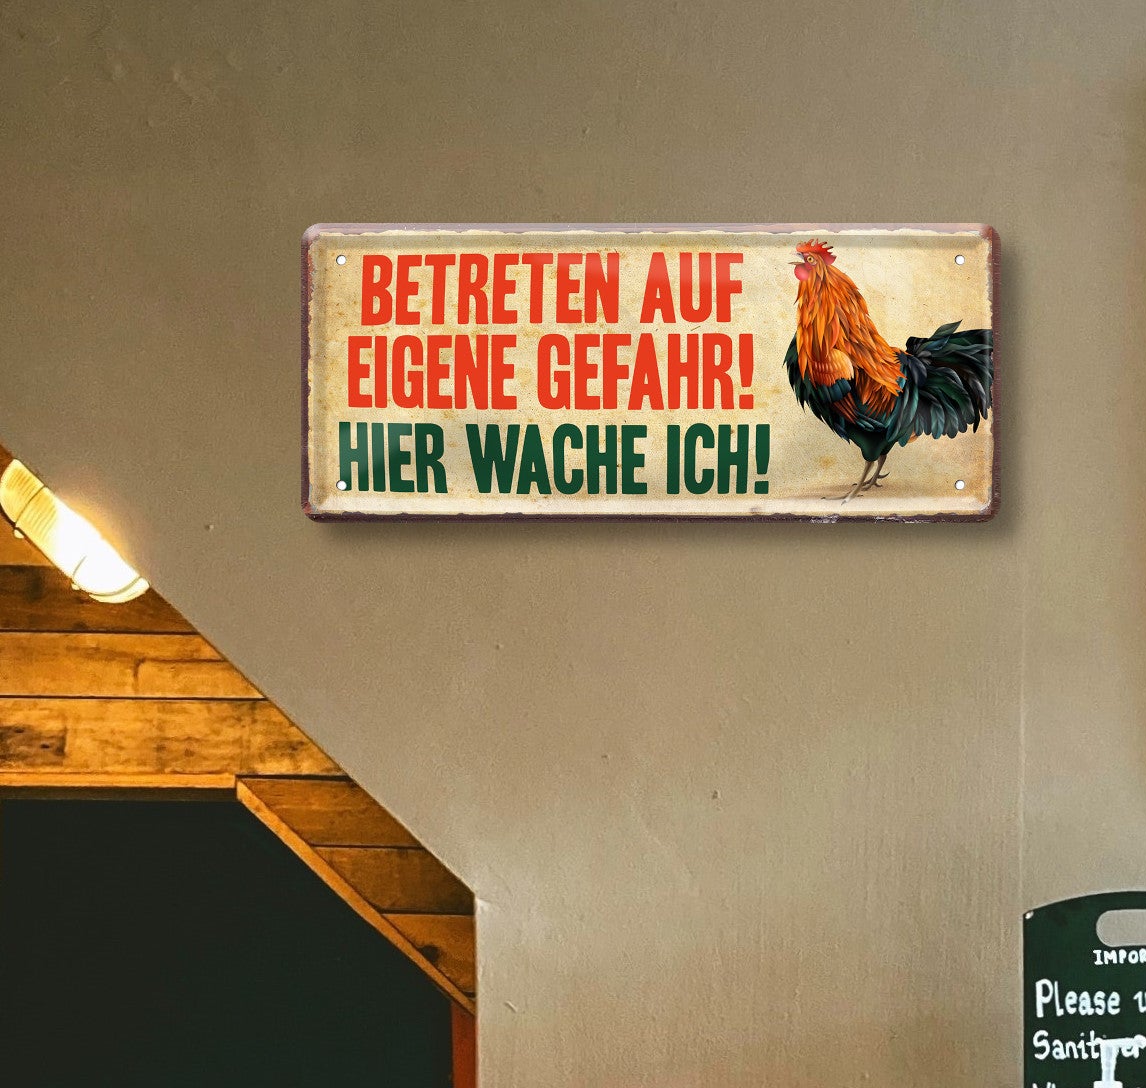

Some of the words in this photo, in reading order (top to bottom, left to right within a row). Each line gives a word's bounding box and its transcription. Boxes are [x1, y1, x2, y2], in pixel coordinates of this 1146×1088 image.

[361, 252, 620, 326] BETRETEN
[640, 252, 744, 324] AUF
[348, 334, 517, 410] EIGENE
[537, 332, 754, 410] GEFAHR!
[339, 421, 448, 494] HIER
[466, 423, 648, 495] WACHE
[667, 423, 771, 494] ICH!
[1035, 979, 1121, 1018] Please
